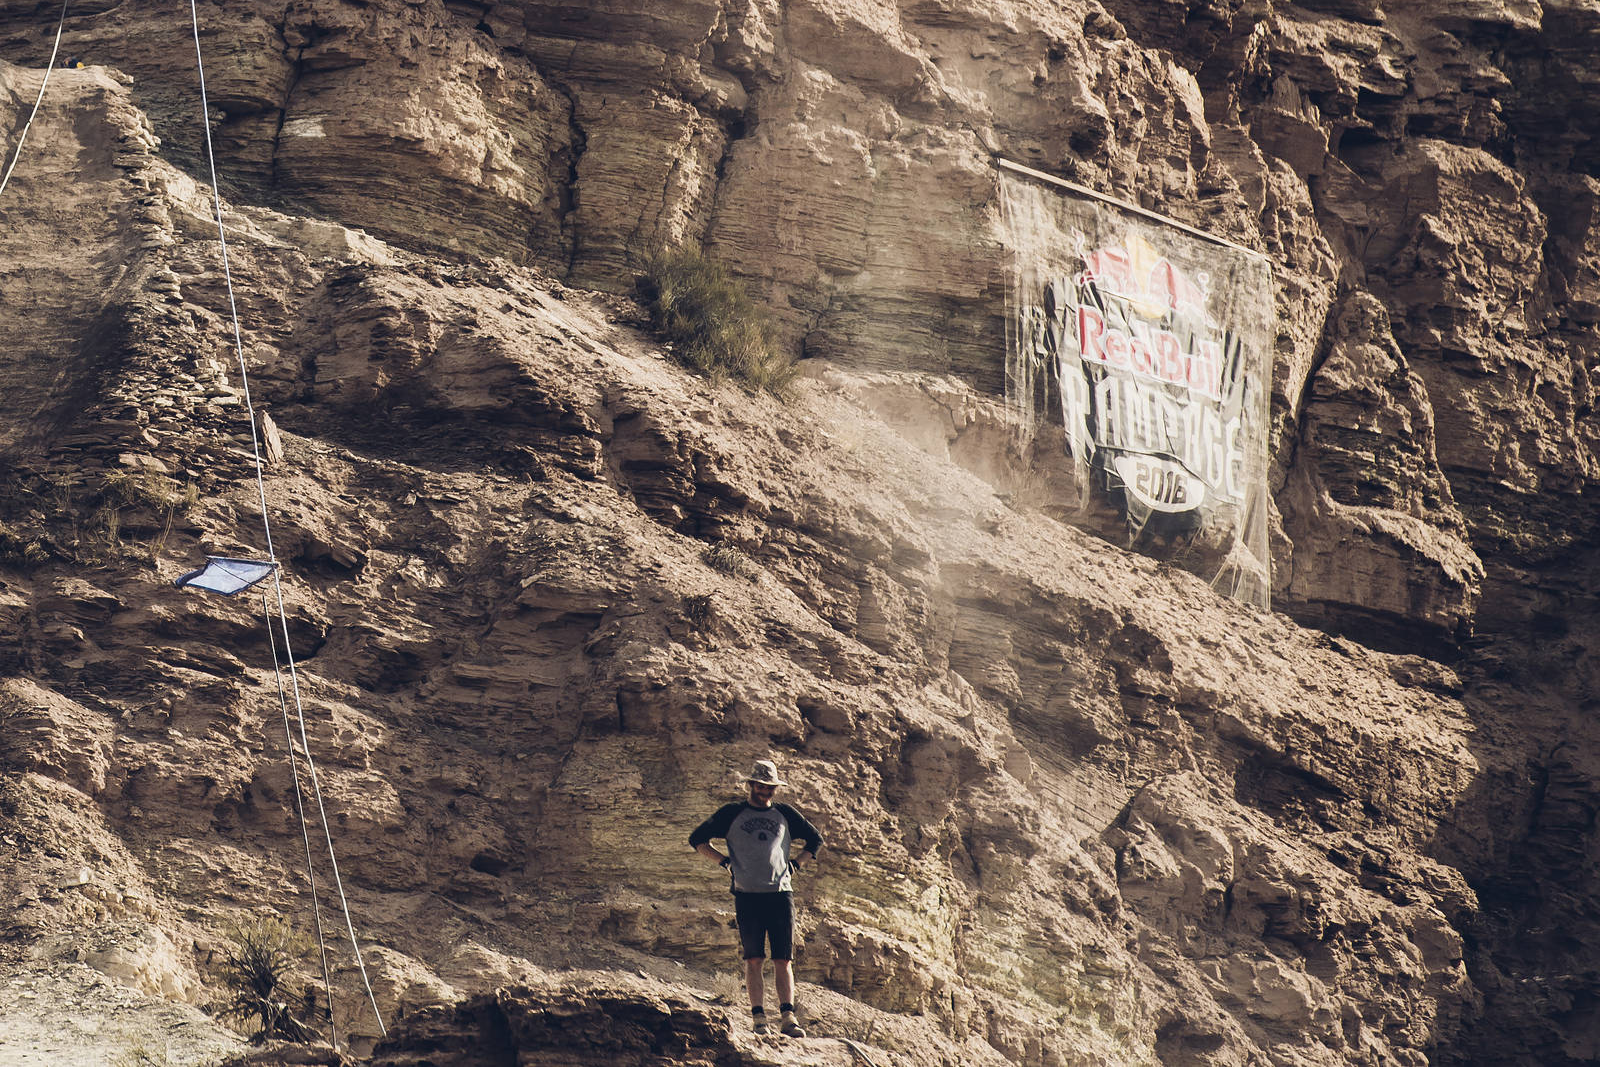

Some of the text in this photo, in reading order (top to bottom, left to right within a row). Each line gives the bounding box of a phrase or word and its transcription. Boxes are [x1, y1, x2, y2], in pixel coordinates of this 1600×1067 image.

[1077, 304, 1222, 402] Red Bull
[1060, 362, 1245, 500] RAMPAGE
[1135, 462, 1188, 505] 2016
